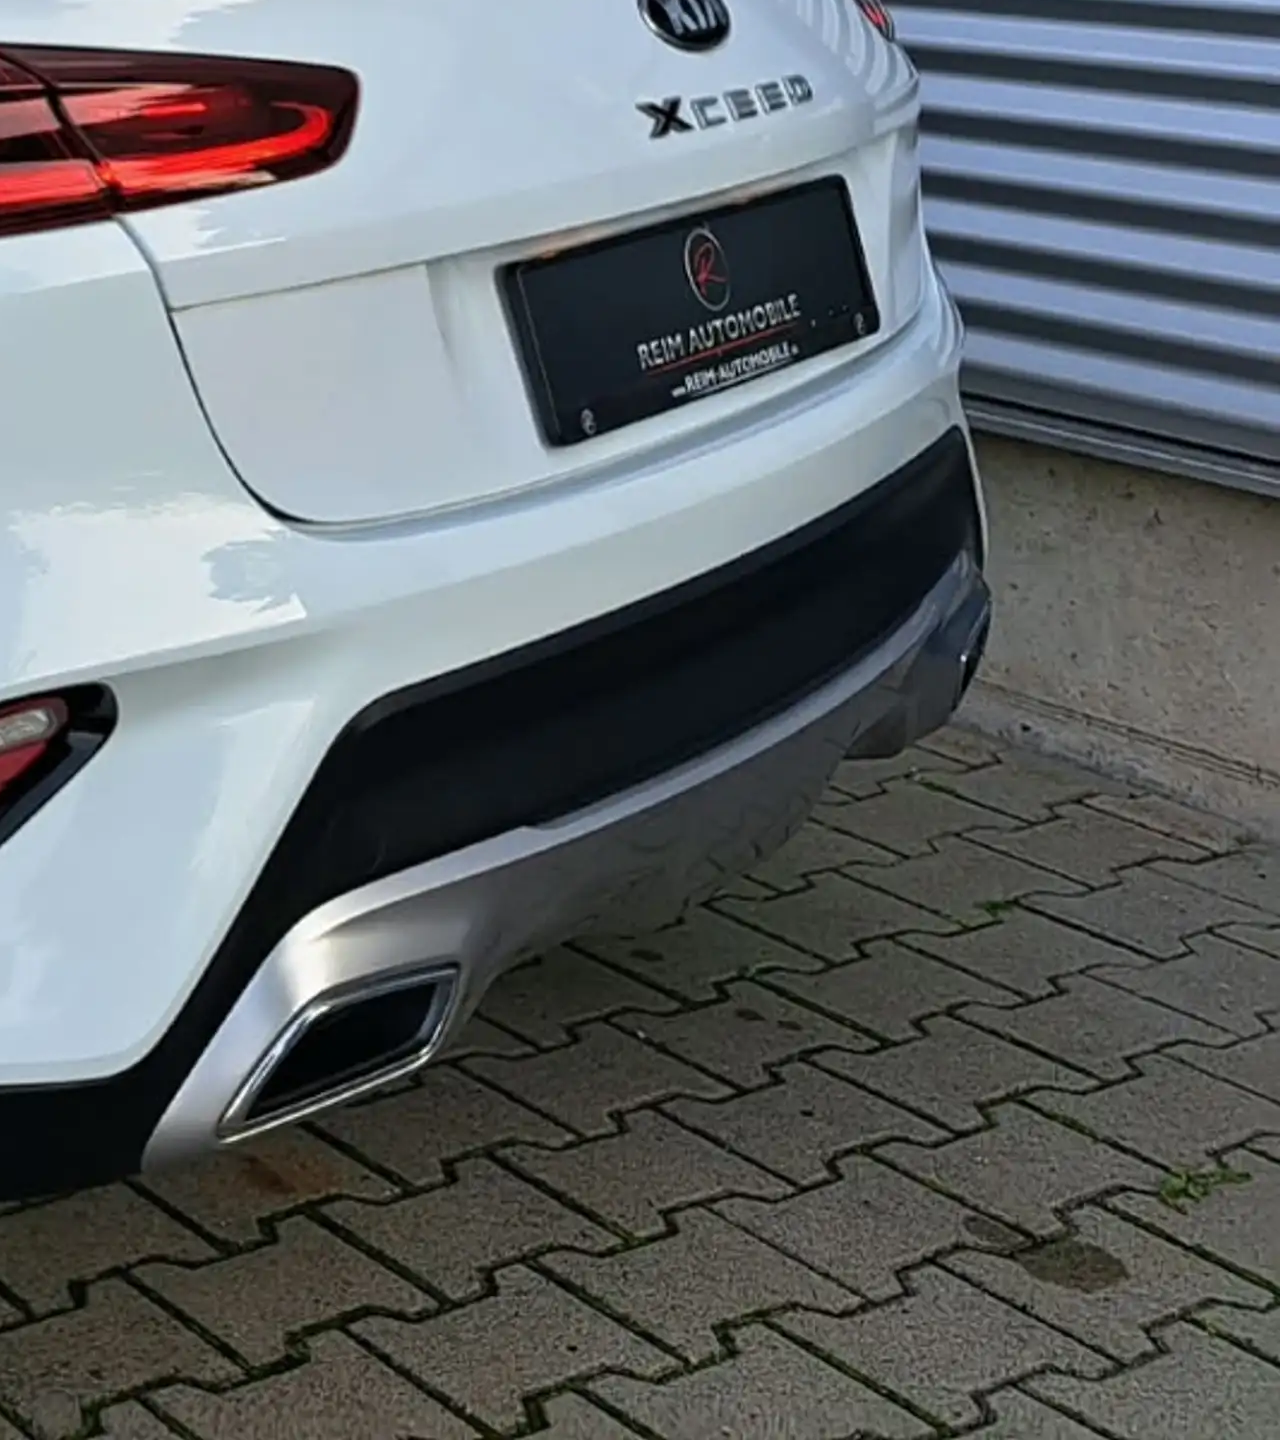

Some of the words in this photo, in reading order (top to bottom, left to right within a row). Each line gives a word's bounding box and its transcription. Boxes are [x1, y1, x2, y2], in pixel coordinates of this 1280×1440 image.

[635, 73, 814, 140] XCEED
[636, 332, 686, 371] REIM
[688, 293, 802, 352] AUTOMOBILE
